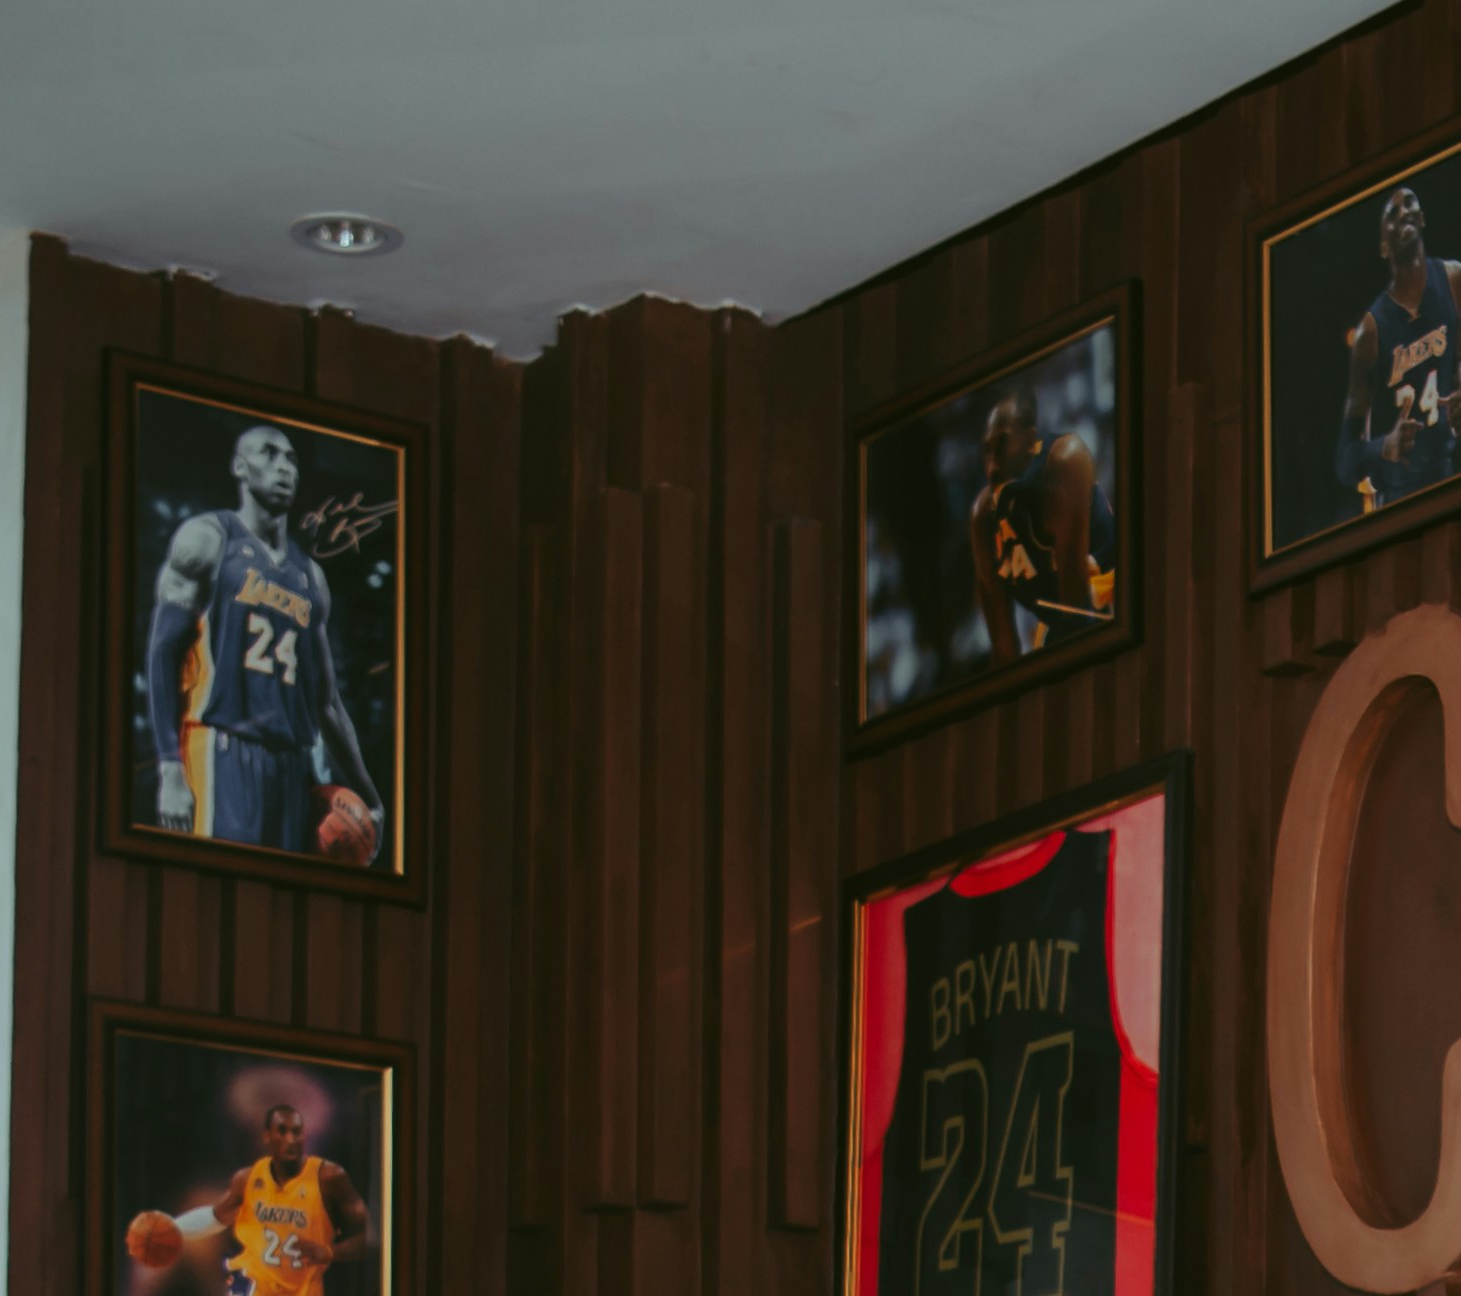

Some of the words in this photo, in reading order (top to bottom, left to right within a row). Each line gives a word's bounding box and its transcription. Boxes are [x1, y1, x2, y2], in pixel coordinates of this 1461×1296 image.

[244, 612, 299, 686] 24
[930, 940, 1080, 1051] BRYANT
[263, 1227, 303, 1270] 24
